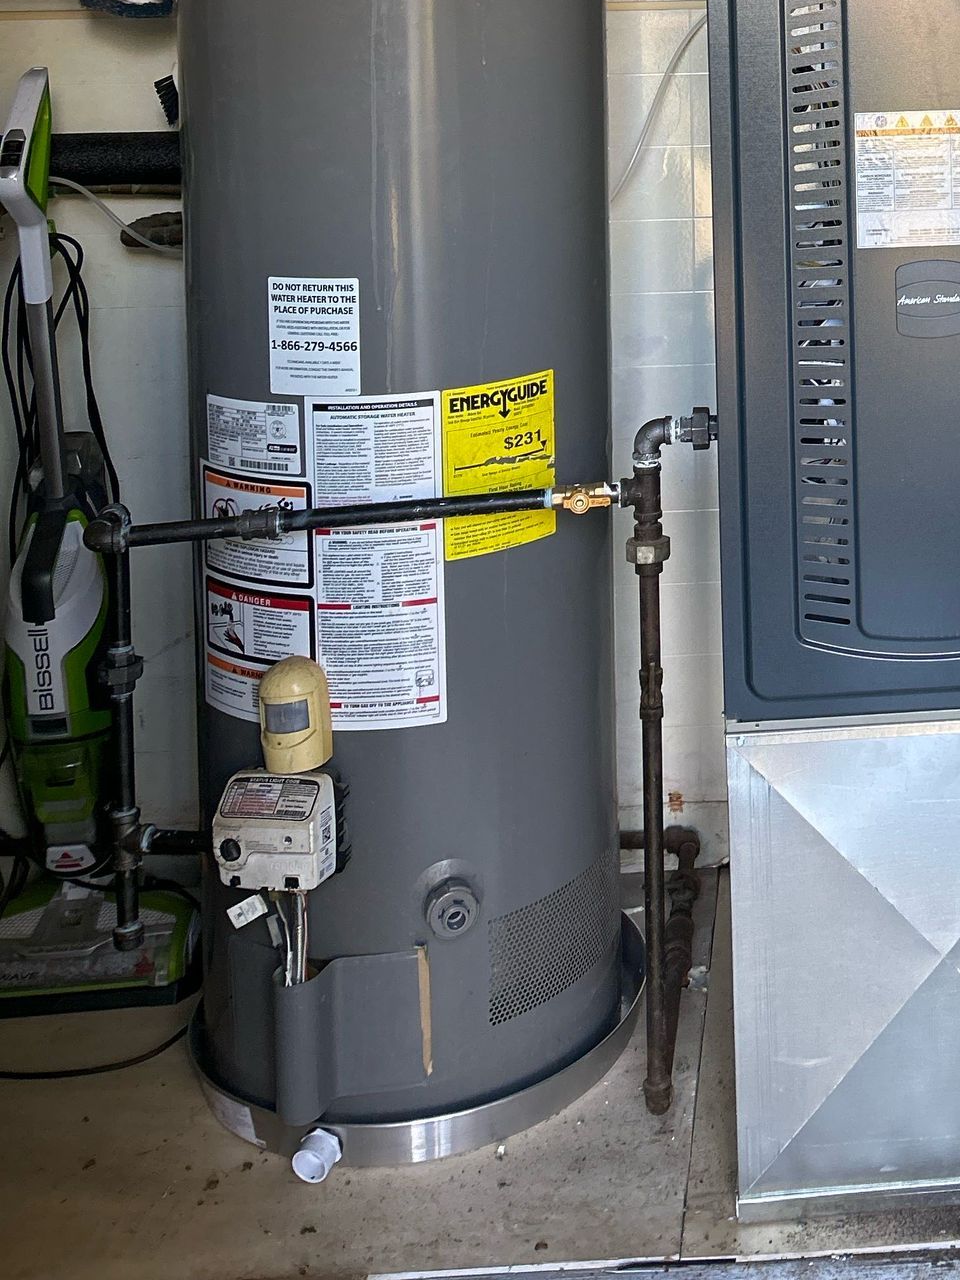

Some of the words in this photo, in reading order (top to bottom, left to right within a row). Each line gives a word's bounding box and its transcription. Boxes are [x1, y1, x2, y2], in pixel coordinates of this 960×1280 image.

[273, 283, 284, 291] DO
[285, 283, 301, 292] NOT
[302, 284, 334, 292] RETURN
[335, 284, 354, 292] THIS
[271, 294, 296, 302] WATER
[297, 295, 327, 303] HEATER
[328, 295, 339, 303] TO
[340, 295, 356, 303] THE
[897, 295, 930, 306] American
[274, 305, 297, 314] PLACE
[298, 306, 309, 314] OF
[310, 307, 353, 315] PURCHASE
[271, 340, 358, 352] 1-866-279-4566
[504, 429, 541, 450] $231
[233, 483, 271, 494] WARNING
[239, 594, 271, 606] DANGER
[241, 669, 263, 679] WARN
